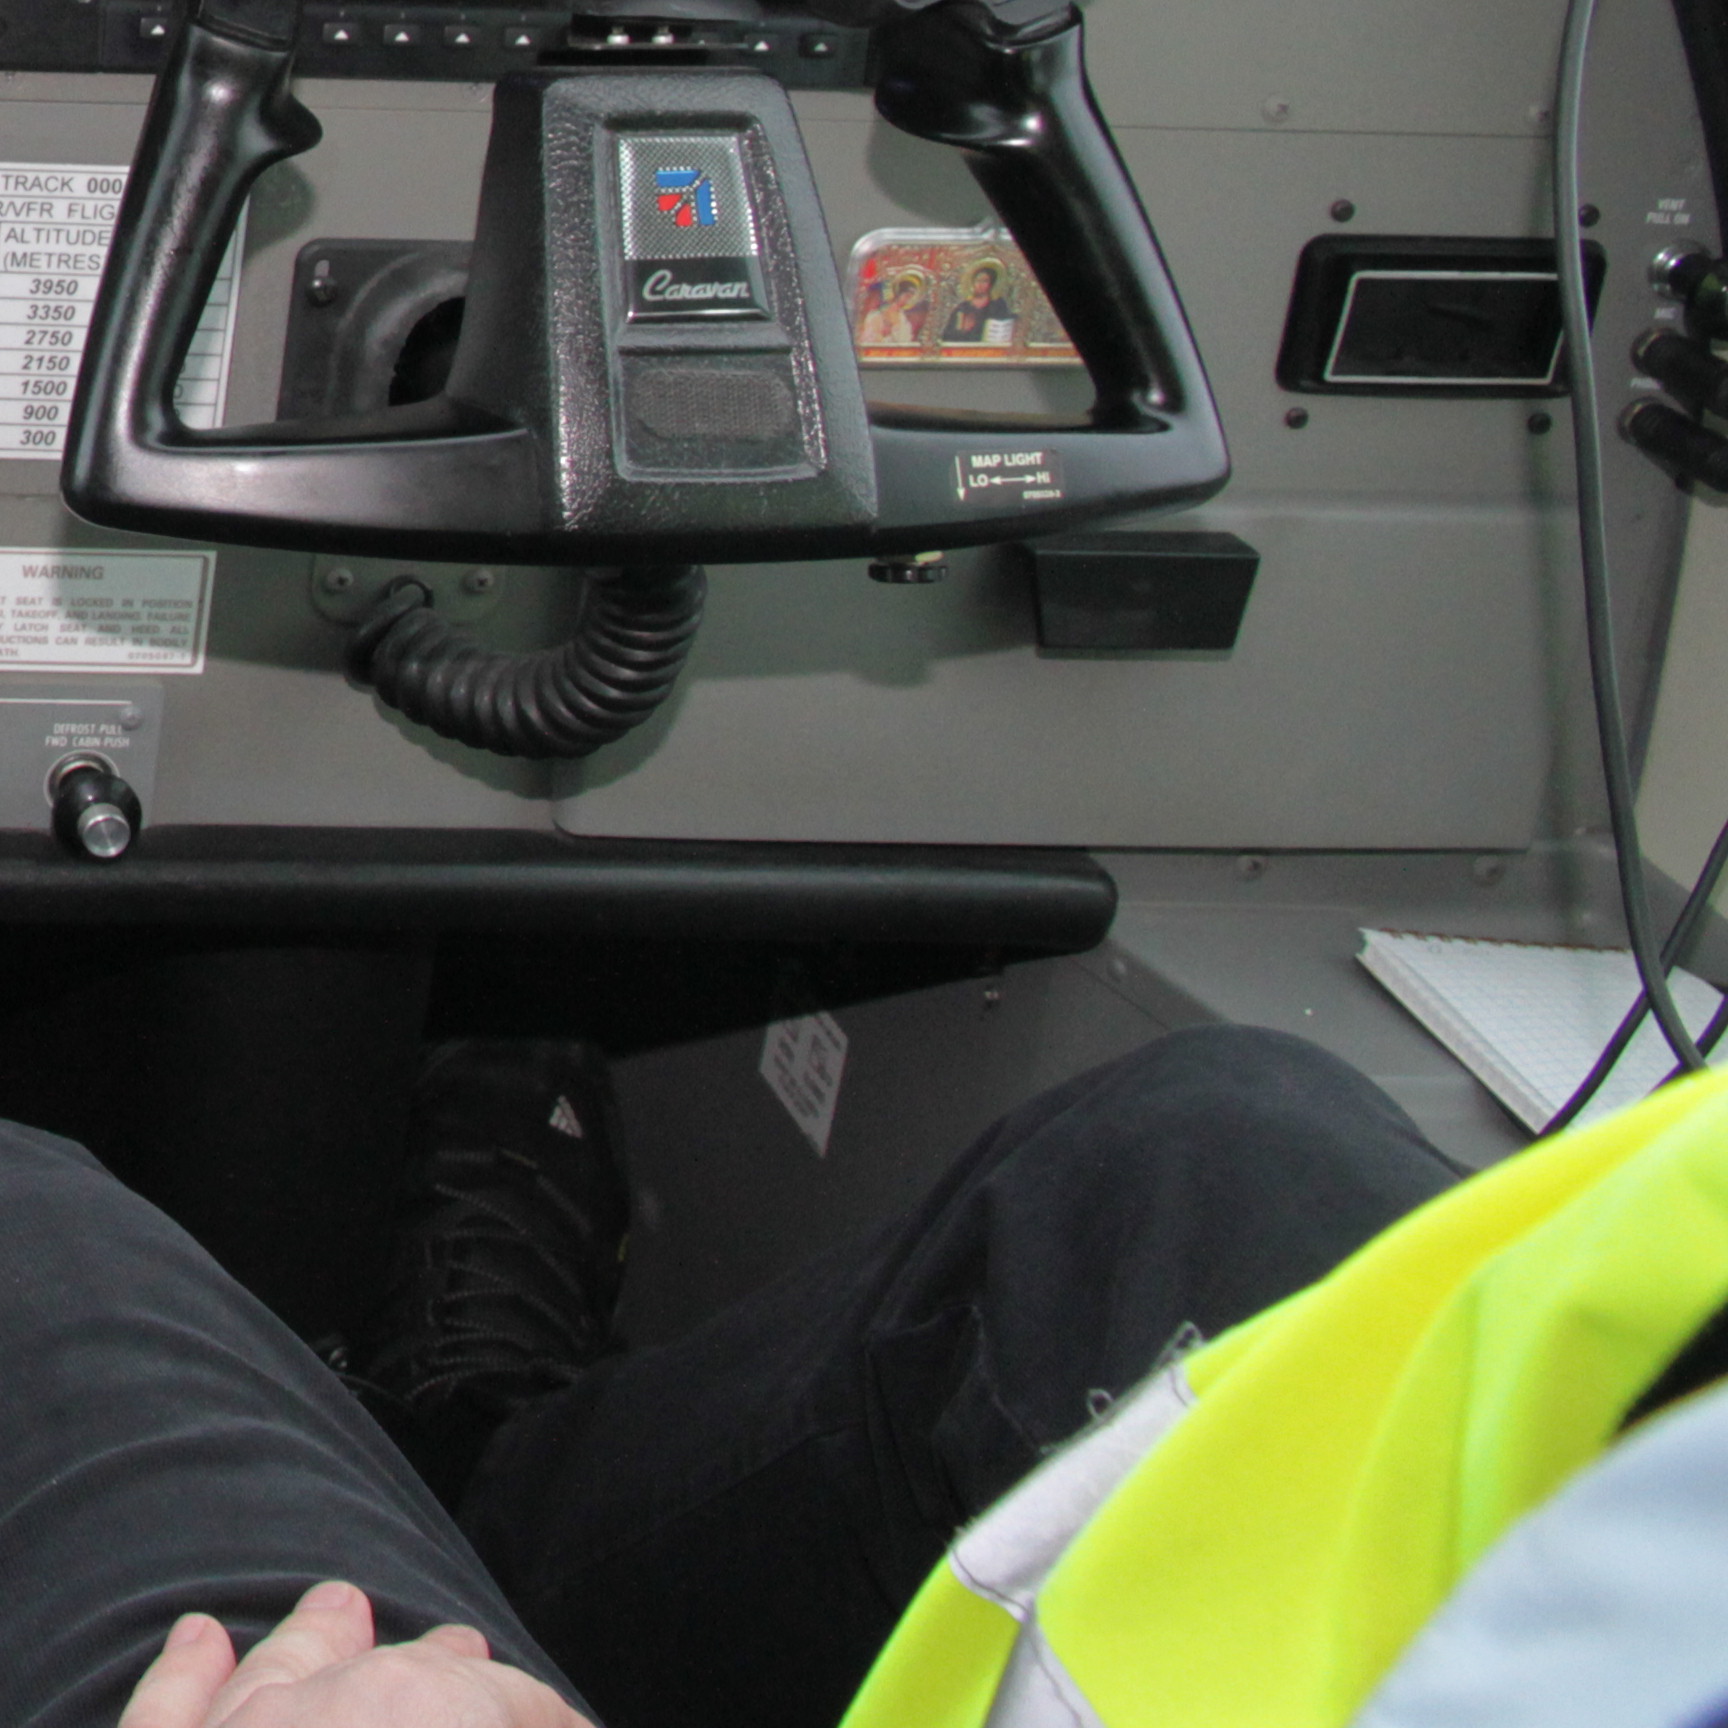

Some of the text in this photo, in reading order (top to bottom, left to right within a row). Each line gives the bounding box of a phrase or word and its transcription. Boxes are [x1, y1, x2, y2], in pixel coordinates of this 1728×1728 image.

[2, 174, 74, 192] TRACK
[87, 179, 122, 195] 000
[5, 229, 109, 247] ALTITUDE
[29, 279, 78, 296] 3950
[643, 271, 750, 302] Caravan
[27, 305, 75, 321] 3350
[24, 330, 72, 346] 2750
[22, 355, 69, 372] 2150
[20, 380, 67, 396] 1500
[23, 405, 58, 422] 900
[20, 431, 56, 447] 300
[971, 452, 1042, 468] MAP LIGHT
[969, 471, 1051, 487] LO HI
[22, 564, 104, 581] WARNING
